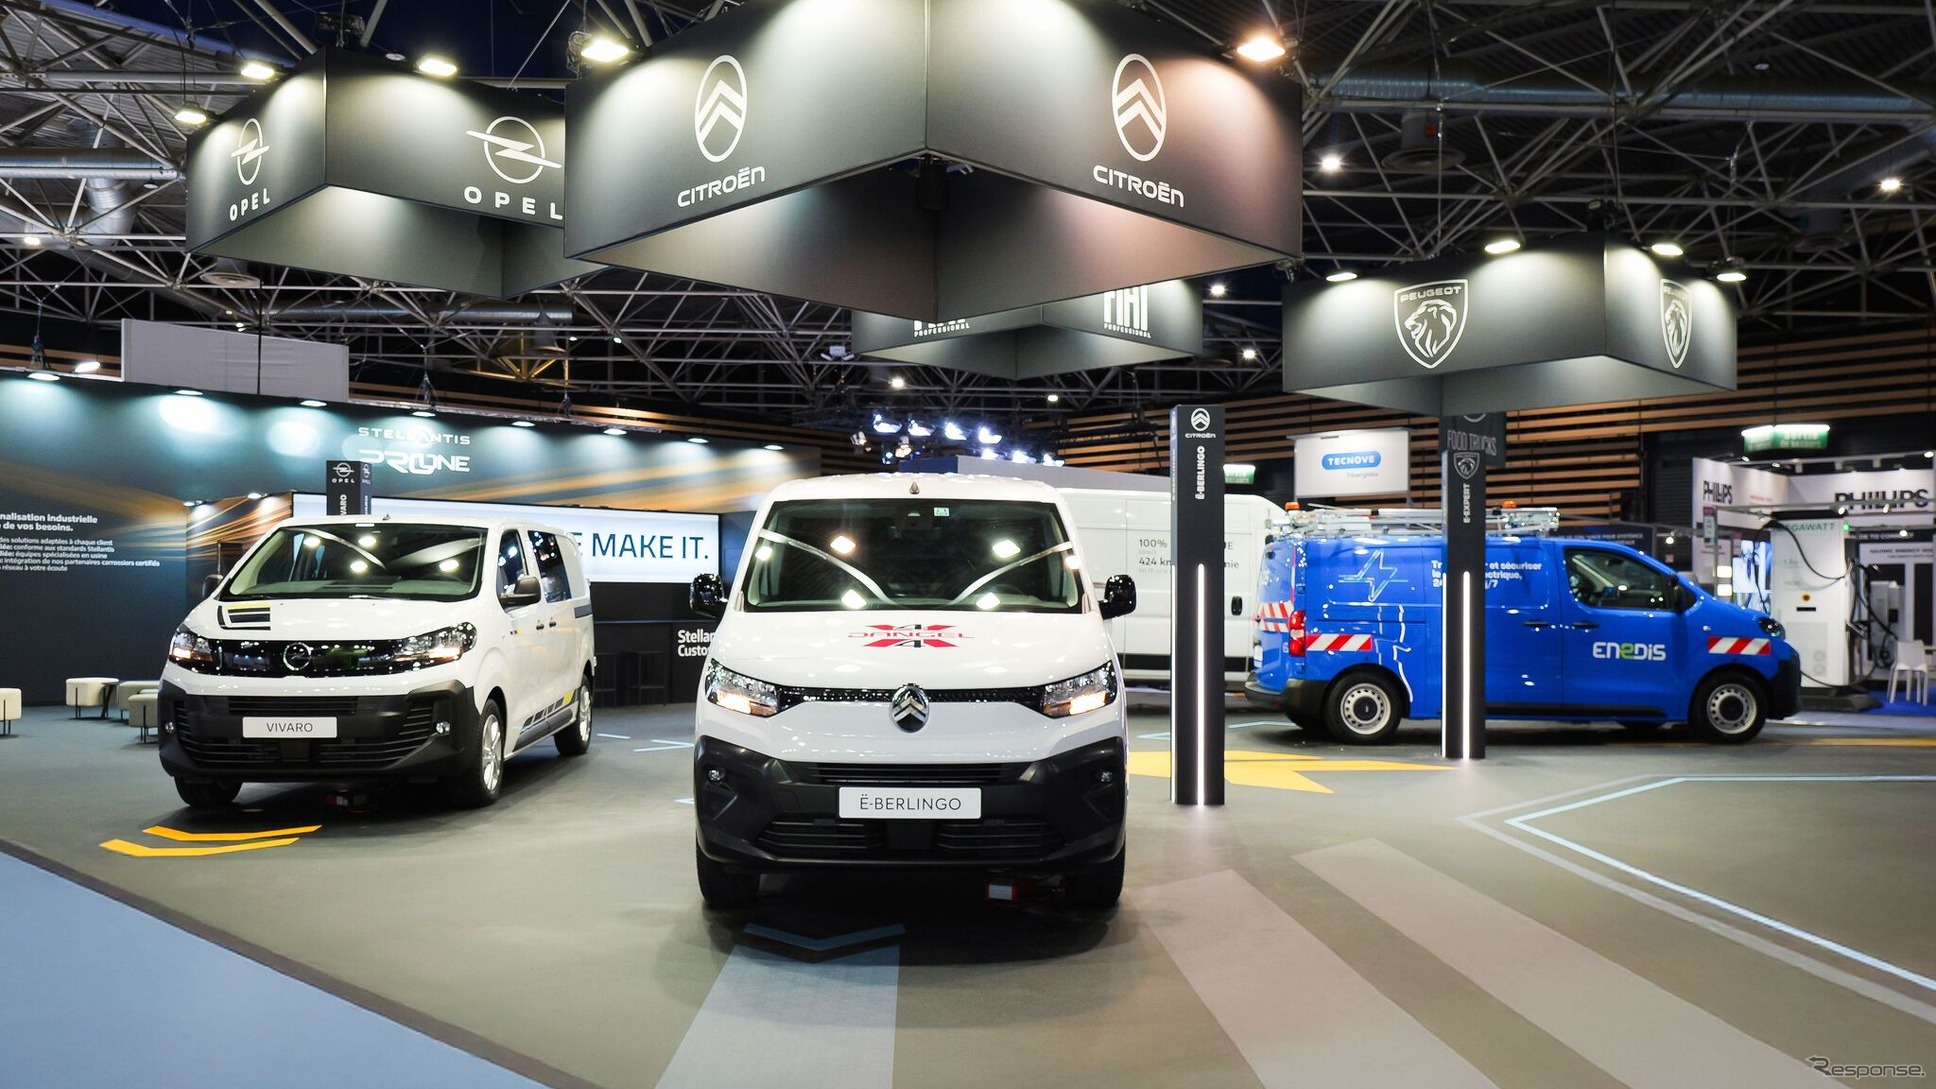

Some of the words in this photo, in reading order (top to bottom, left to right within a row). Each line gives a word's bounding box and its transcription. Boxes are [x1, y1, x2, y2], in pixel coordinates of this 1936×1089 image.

[229, 188, 271, 222] OPEL
[464, 186, 563, 221] OPEL
[1400, 286, 1462, 303] PEUGEOT
[1327, 455, 1376, 466] TECNOVE
[1702, 480, 1733, 505] PHILIPS
[1834, 488, 1929, 511] PHILIPS
[47, 513, 98, 524] industrielle
[2, 521, 15, 530] de
[16, 523, 34, 531] vos
[35, 522, 74, 532] besoins.
[592, 533, 674, 558] MAKE
[682, 536, 709, 559] IT.
[1139, 538, 1168, 548] 100%
[1138, 556, 1157, 566] 424
[1489, 562, 1499, 570] et
[266, 722, 314, 733] VIVARO
[860, 793, 962, 811] Ë-BERLINGO
